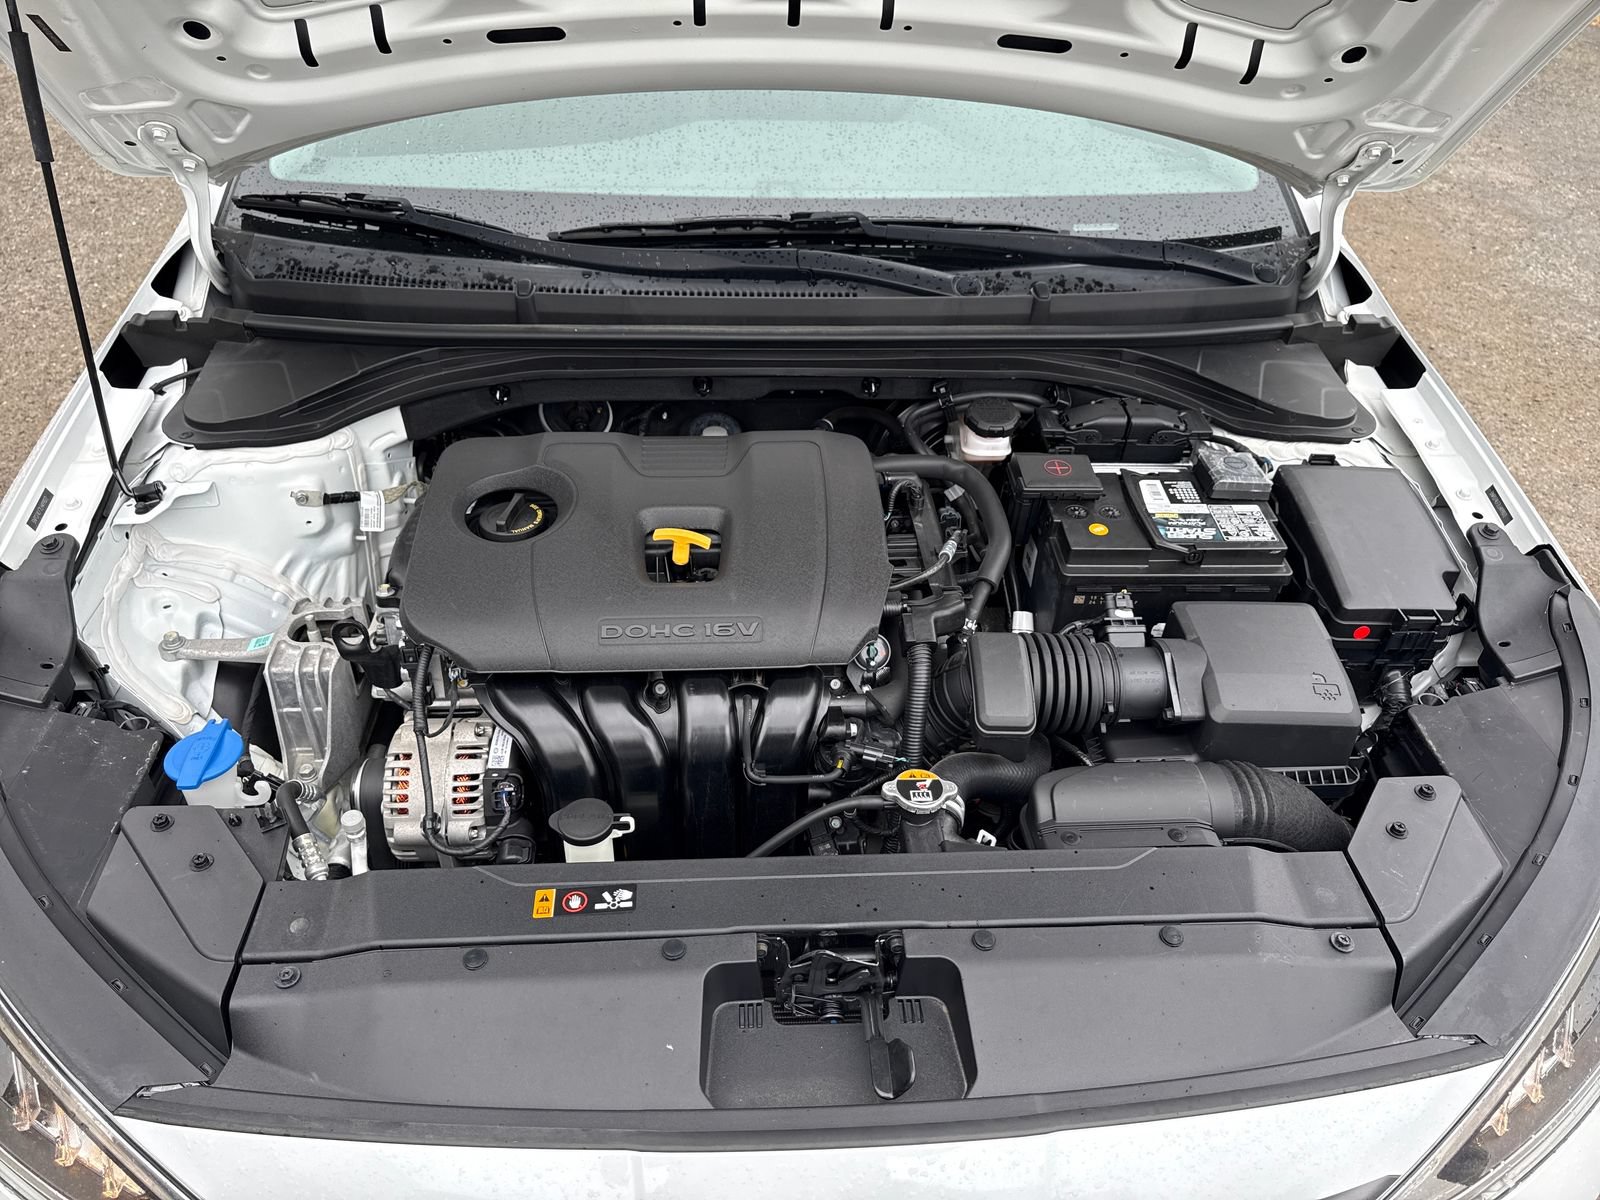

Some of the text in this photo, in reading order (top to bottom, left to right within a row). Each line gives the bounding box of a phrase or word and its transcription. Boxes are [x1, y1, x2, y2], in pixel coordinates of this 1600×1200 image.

[511, 524, 534, 533] MANUAL
[601, 621, 760, 640] DOHC 16V
